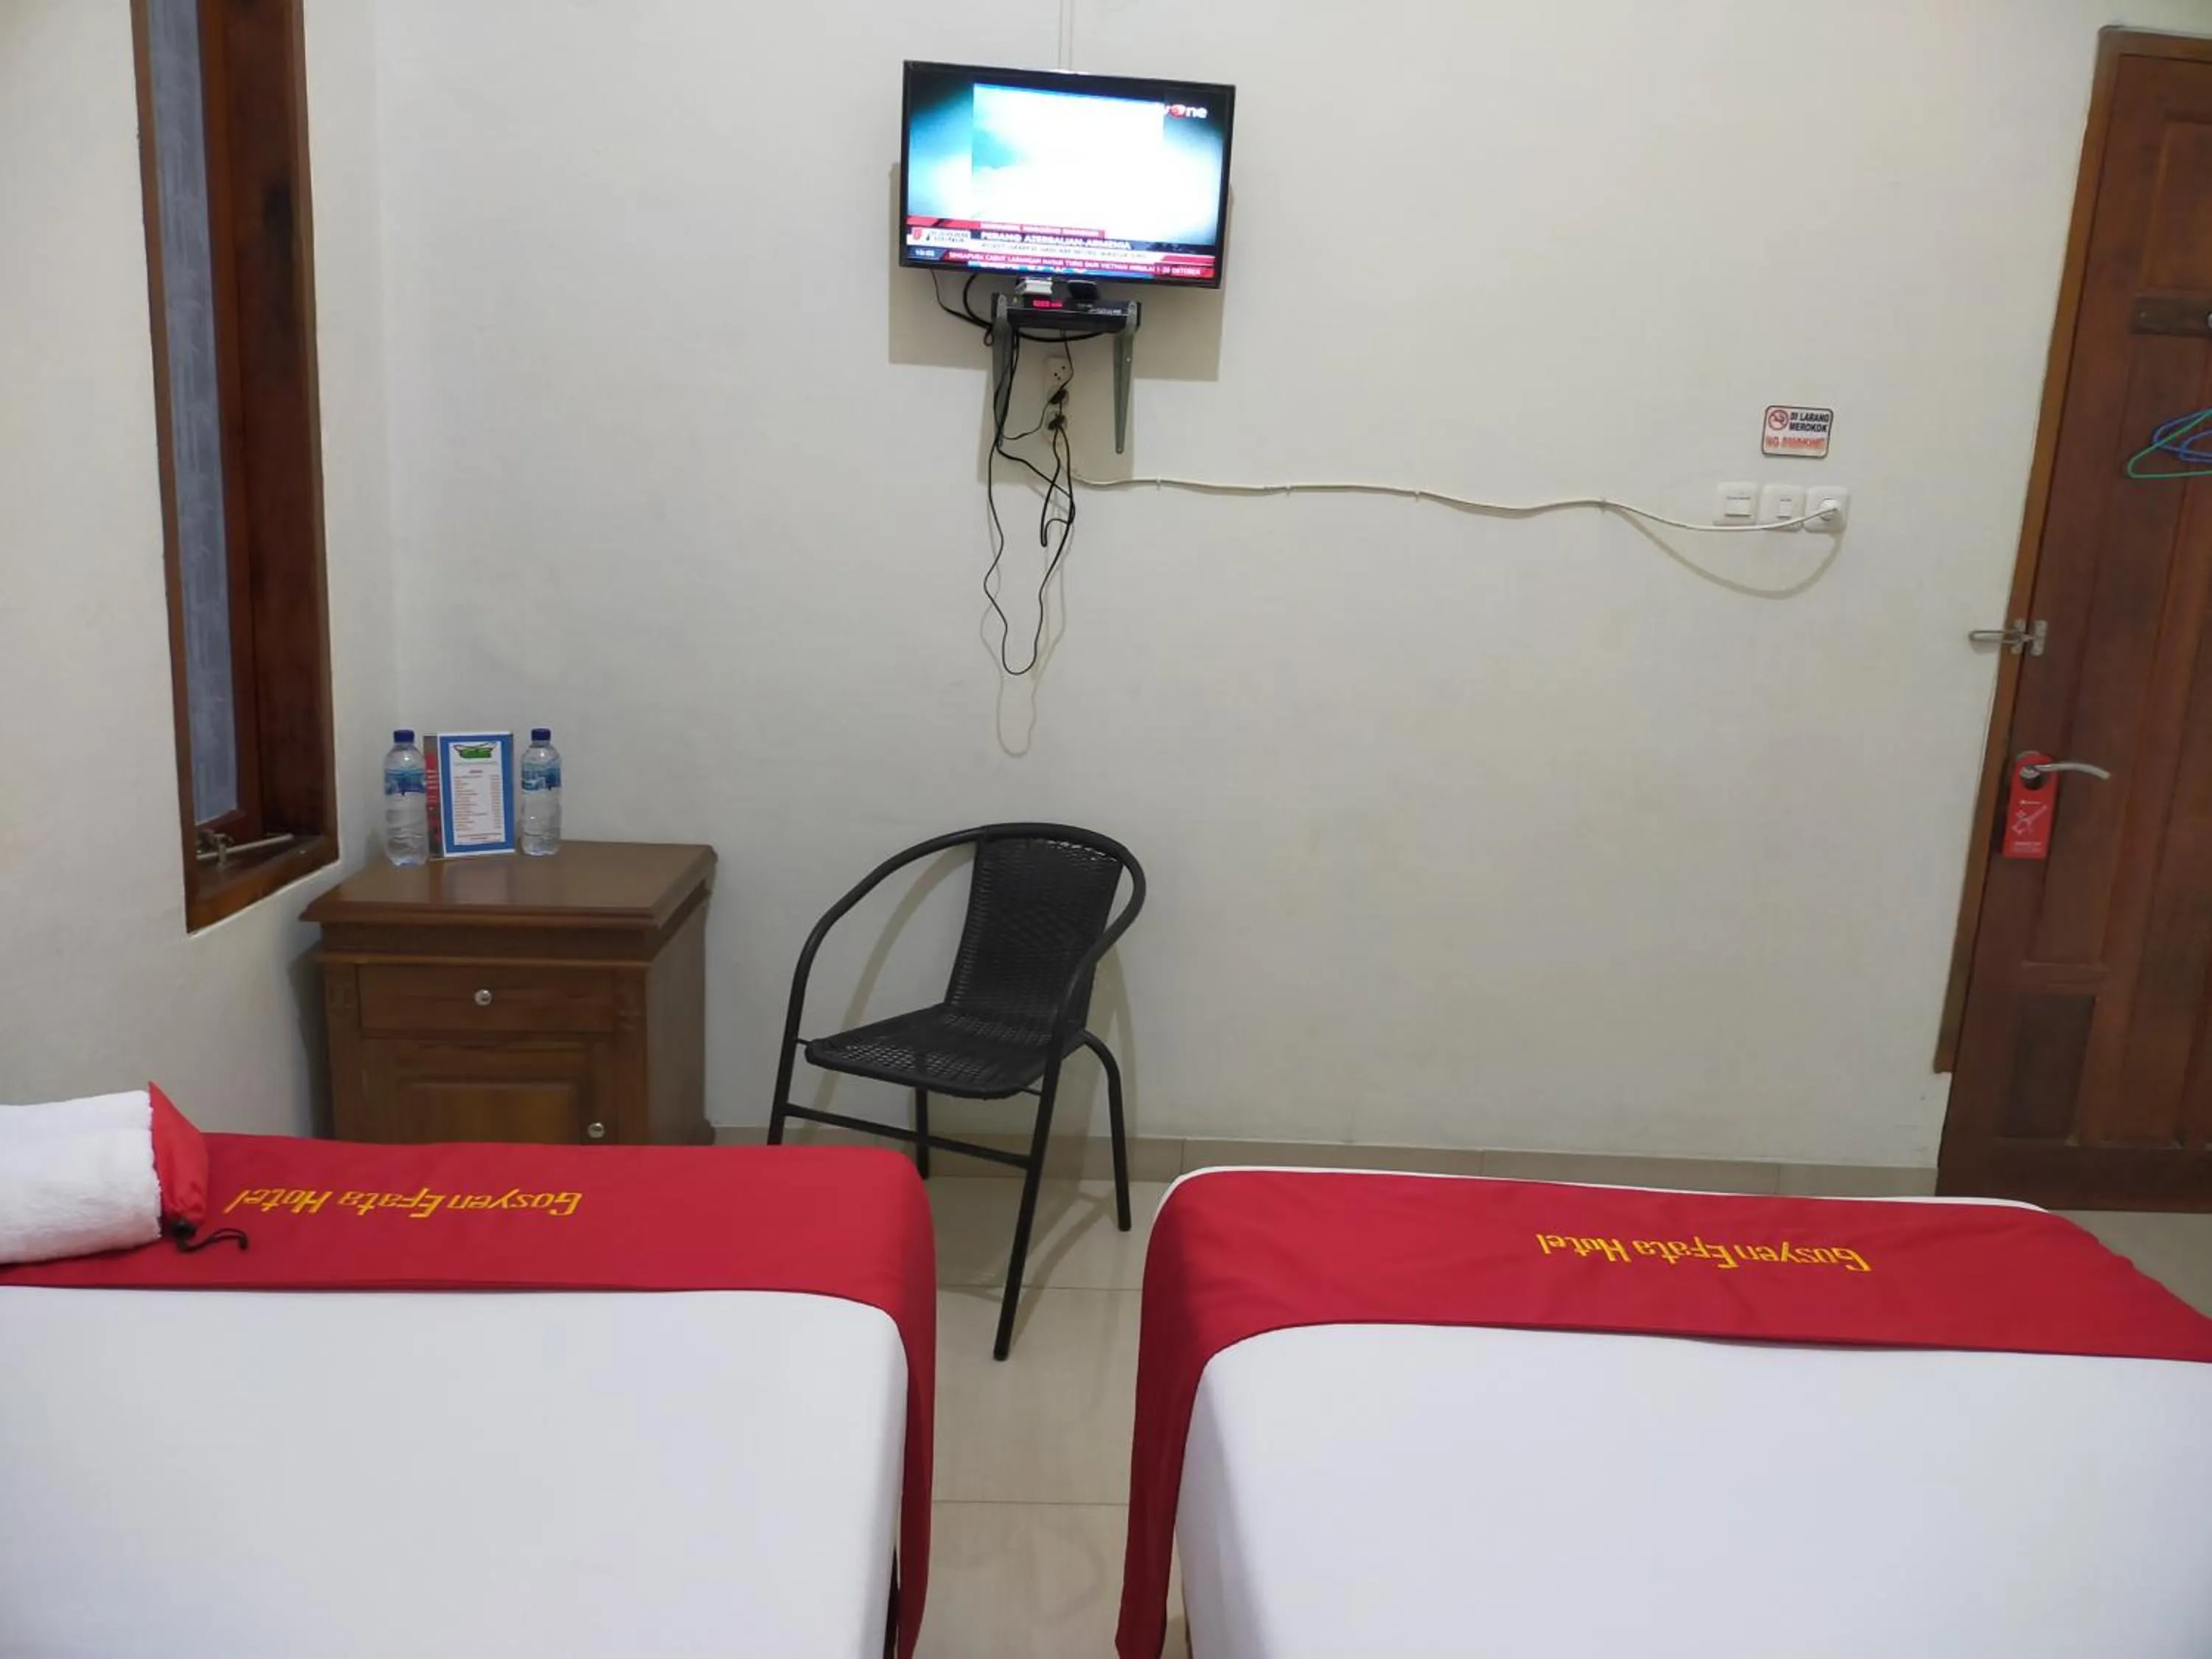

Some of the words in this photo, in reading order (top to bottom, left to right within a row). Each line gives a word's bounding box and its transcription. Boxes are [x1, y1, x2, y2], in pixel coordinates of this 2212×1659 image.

[1790, 412, 1798, 421] DI
[1800, 412, 1829, 422] LARANG
[1790, 422, 1828, 432] MEROKOK
[223, 1189, 333, 1214] Hotel
[338, 1187, 448, 1218] Efata
[448, 1189, 583, 1216] Gosyen
[1535, 1233, 1632, 1264] Hotel
[1632, 1236, 1740, 1268] Efata
